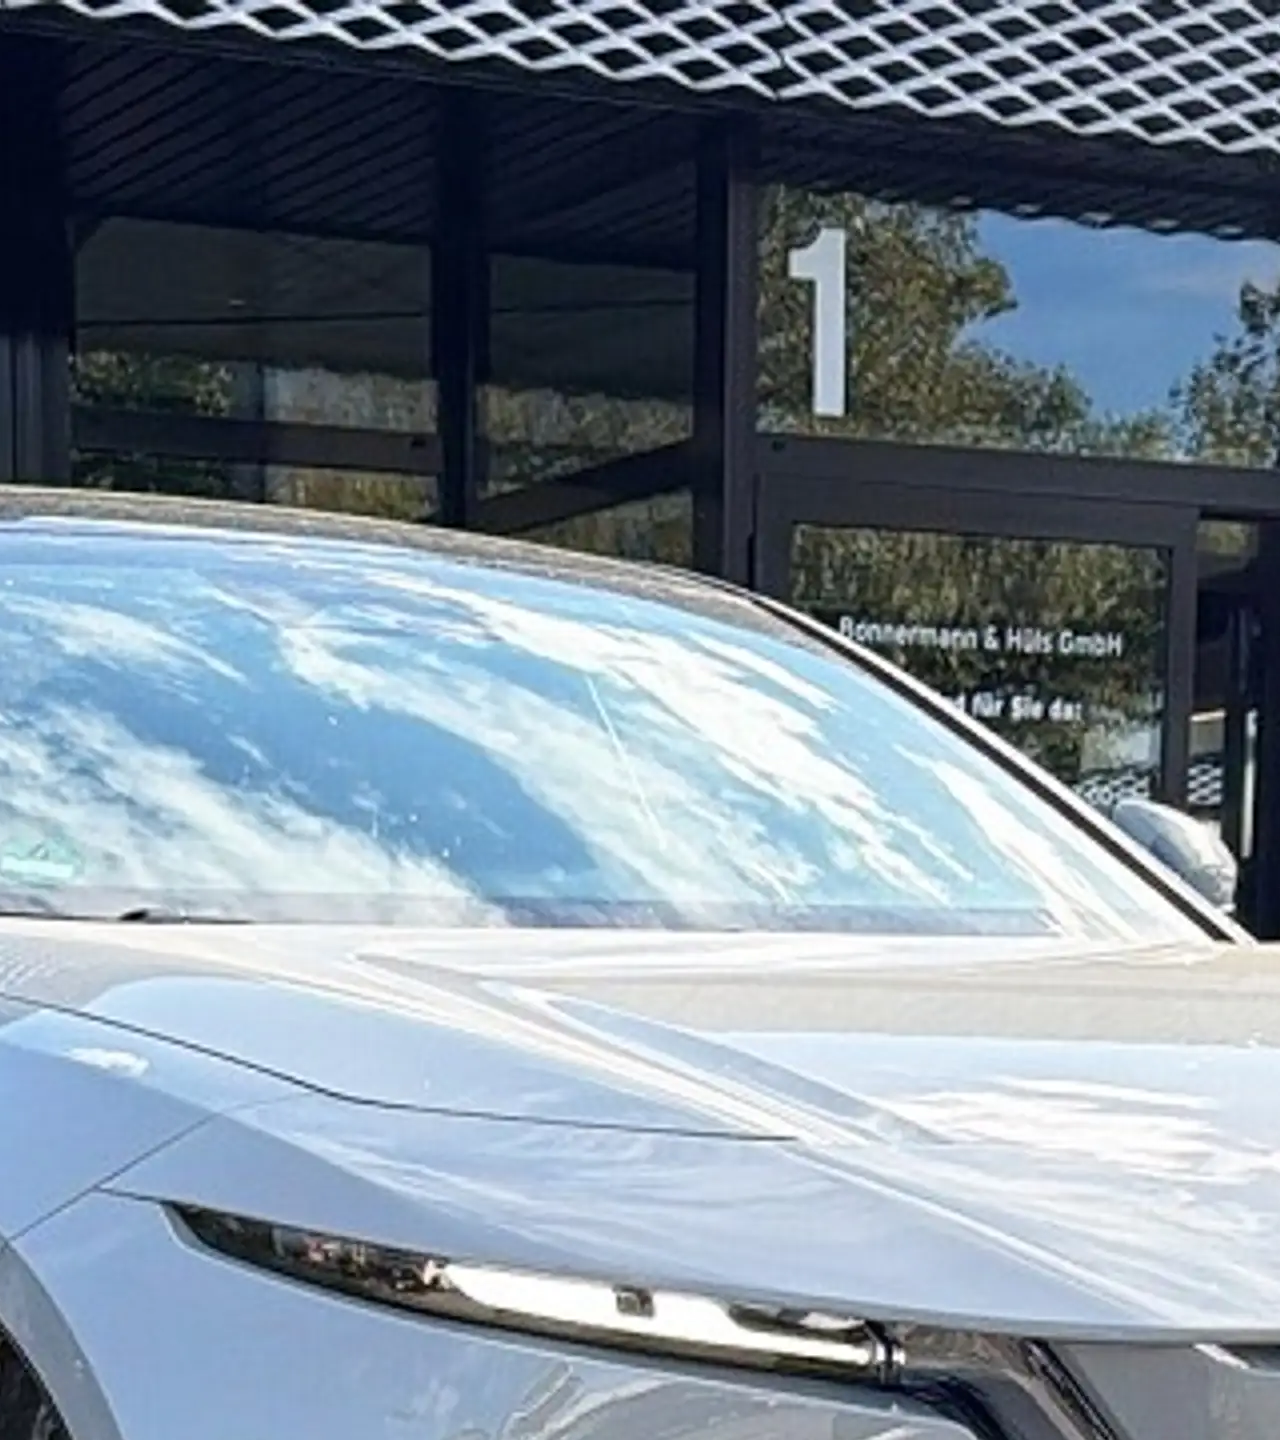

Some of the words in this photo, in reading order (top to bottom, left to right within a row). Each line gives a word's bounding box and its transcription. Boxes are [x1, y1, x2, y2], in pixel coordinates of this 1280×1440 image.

[787, 227, 847, 418] 1
[838, 615, 978, 650] Bonnermann
[983, 624, 1000, 650] &
[1059, 629, 1124, 656] GmbH
